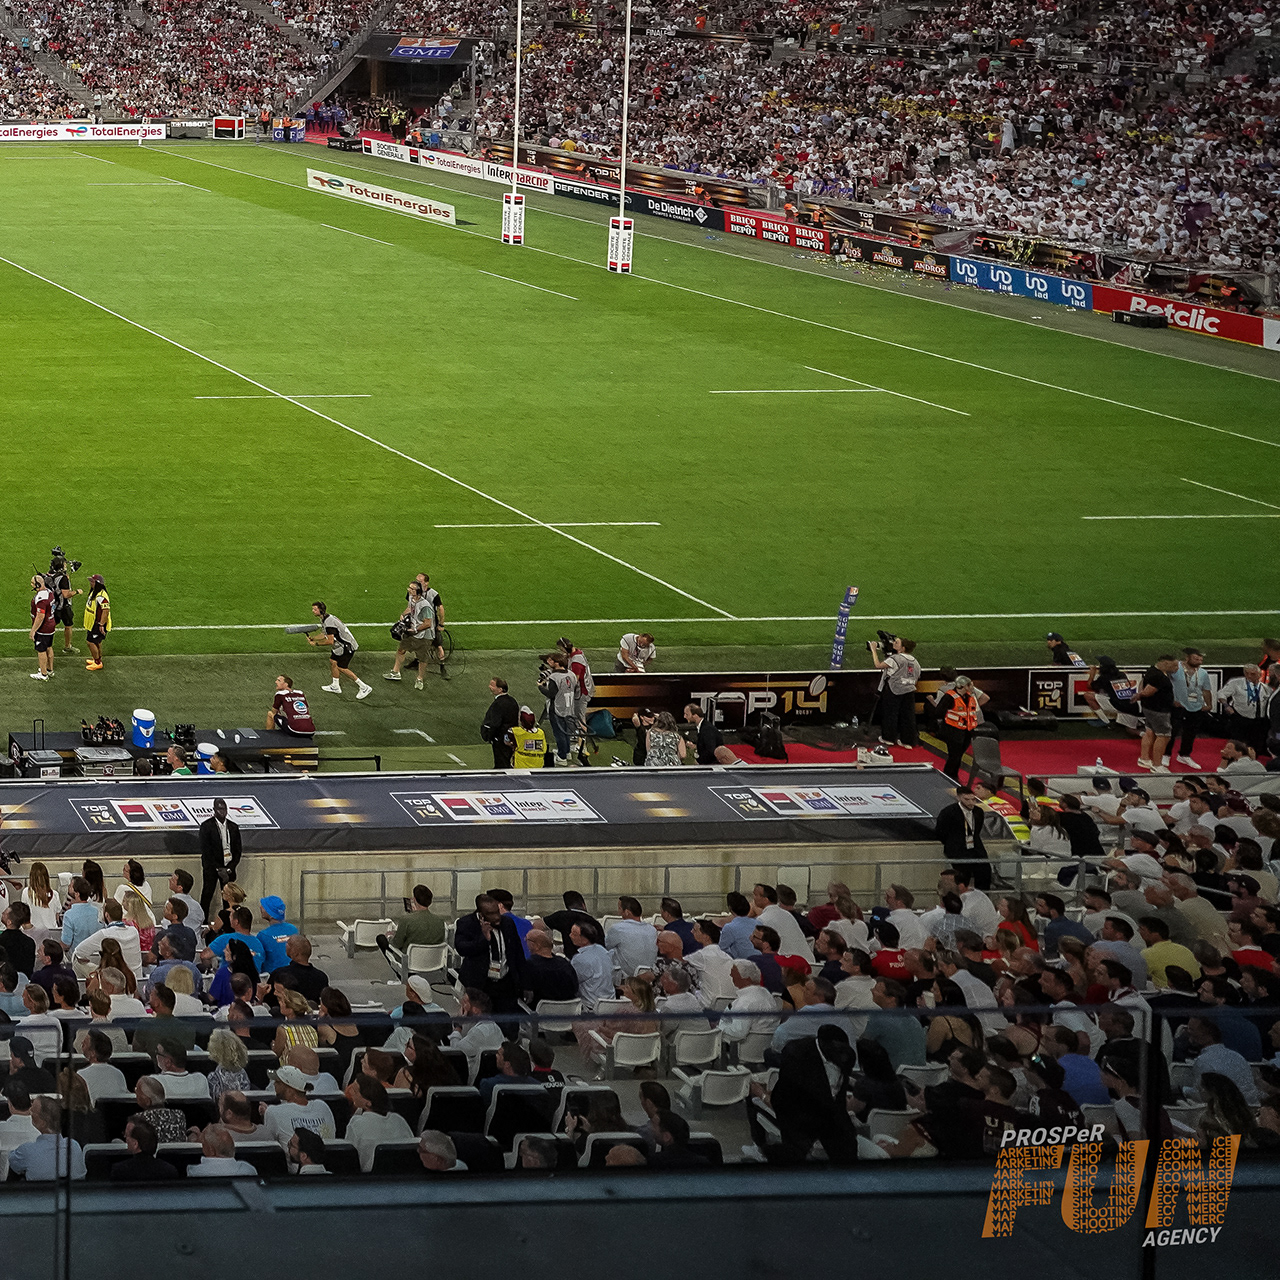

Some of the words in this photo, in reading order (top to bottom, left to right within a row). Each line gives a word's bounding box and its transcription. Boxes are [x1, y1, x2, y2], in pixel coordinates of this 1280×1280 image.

[398, 48, 451, 57] GMF
[275, 131, 296, 141] GF
[437, 156, 481, 174] TotalEnergies
[555, 182, 610, 201] DEFENDER
[346, 182, 451, 219] TotalEnergies
[648, 200, 660, 211] De
[661, 202, 694, 218] Dietrich
[730, 215, 756, 226] BRICO
[731, 224, 757, 236] DEPÔT
[762, 221, 789, 233] BRICO
[763, 230, 790, 244] DEPÔT
[796, 228, 824, 240] BRICO
[796, 237, 825, 251] DEPÔT
[873, 254, 903, 266] ANDROS
[915, 262, 946, 275] ANDROS
[1036, 681, 1063, 689] TOP
[514, 800, 550, 810] Inter
[810, 801, 832, 810] GMF
[834, 795, 867, 804] Inter
[162, 812, 185, 821] GMF
[192, 806, 215, 815] Inte
[488, 807, 510, 815] GMF
